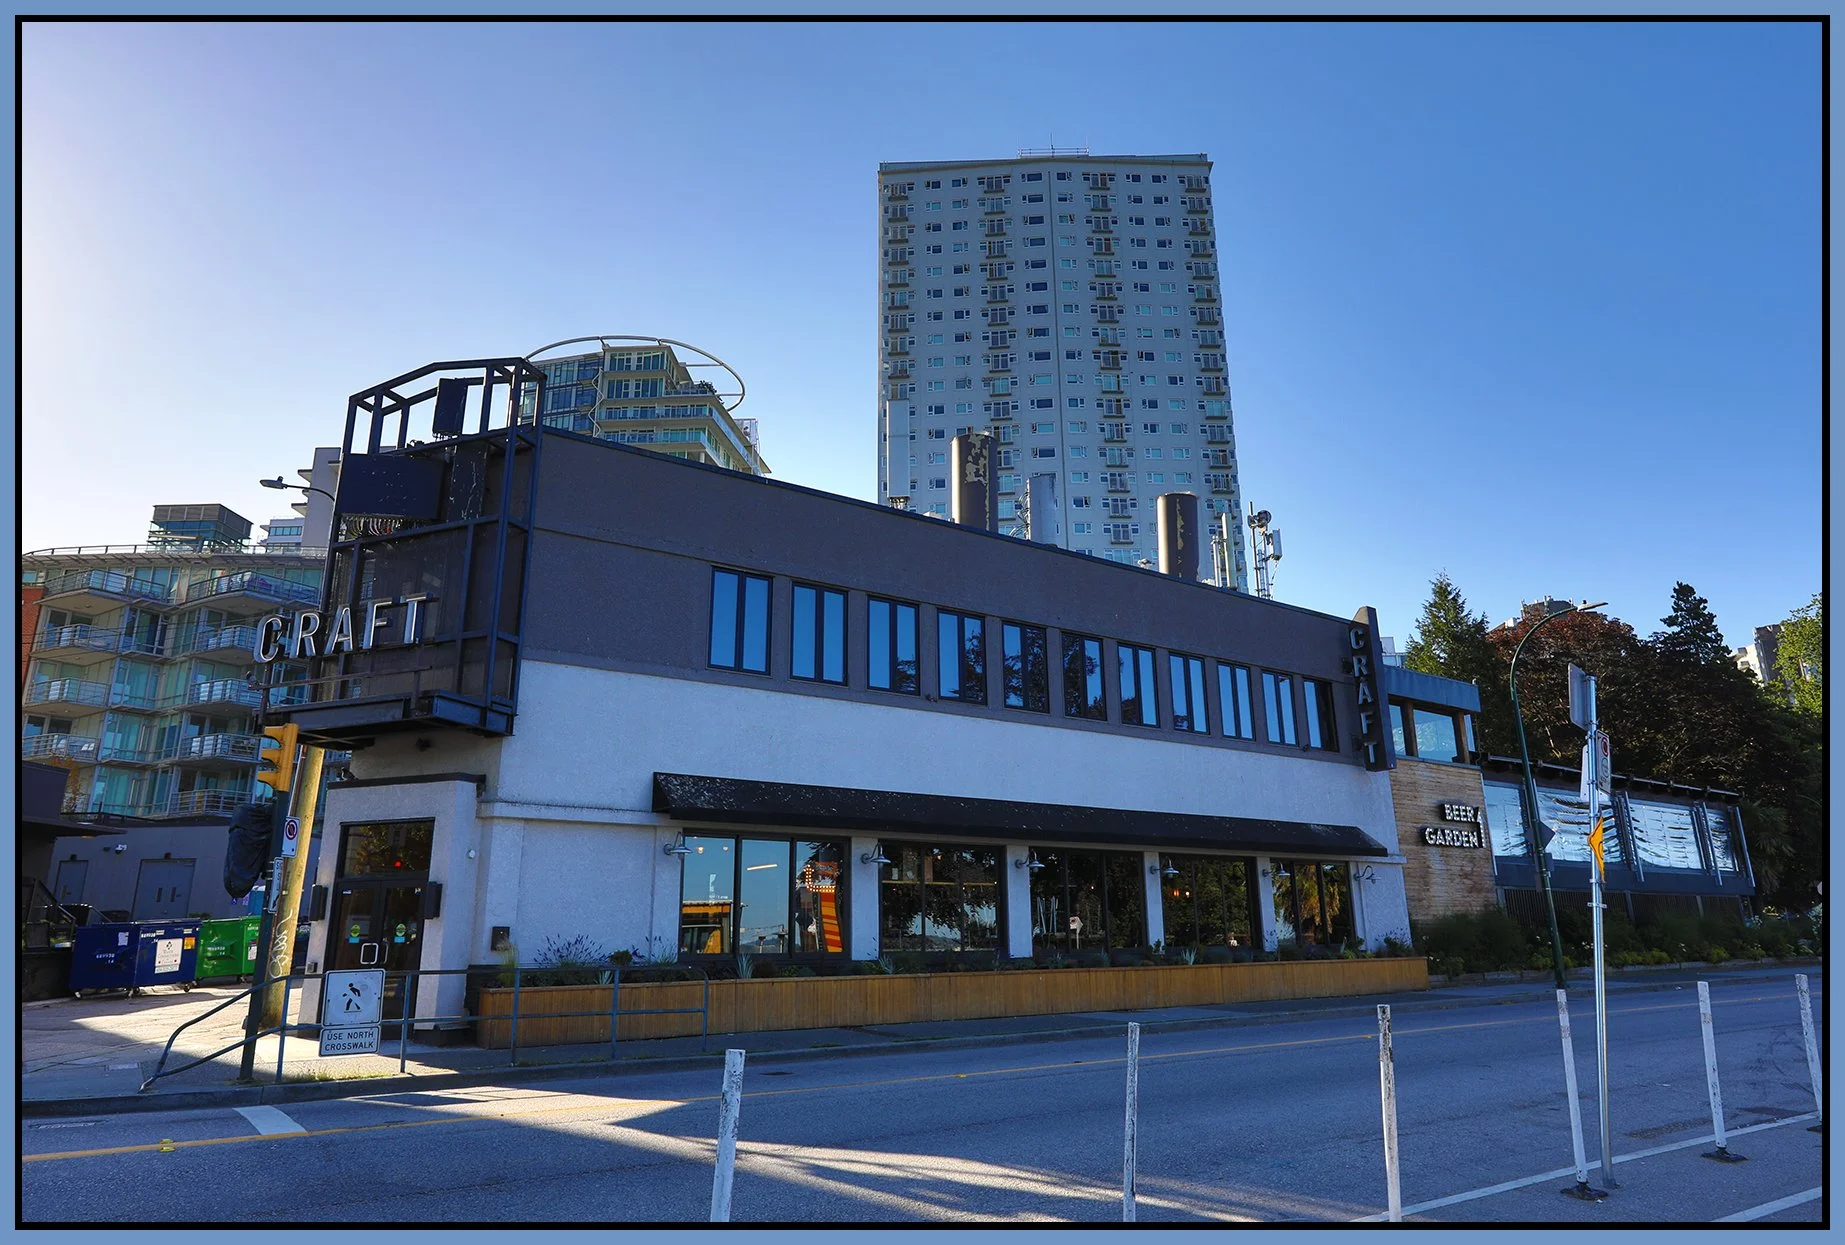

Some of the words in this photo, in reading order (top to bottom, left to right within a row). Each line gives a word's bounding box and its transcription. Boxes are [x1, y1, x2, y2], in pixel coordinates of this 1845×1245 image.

[254, 593, 430, 663] CRAFT
[1350, 627, 1377, 763] CRAFT
[1444, 803, 1475, 822] BEER
[1425, 827, 1479, 848] GARDEN
[324, 1041, 374, 1051] CROSSWALK
[327, 1032, 343, 1041] USE
[347, 1031, 374, 1039] NORTH
